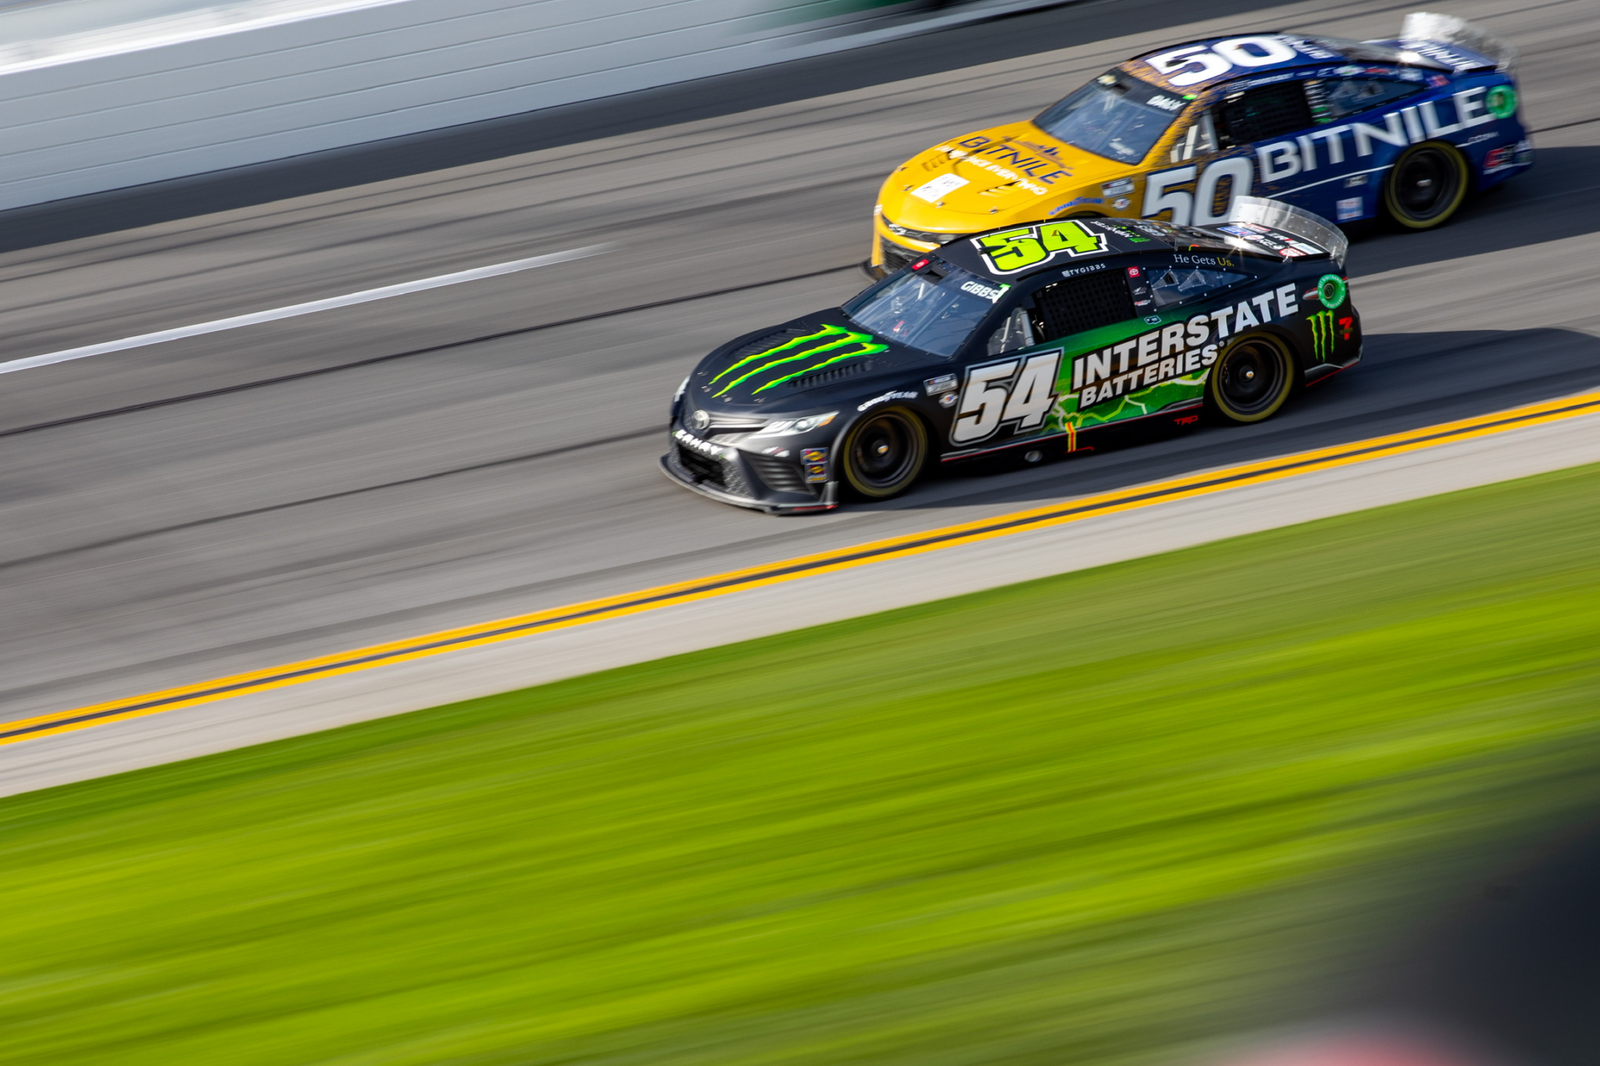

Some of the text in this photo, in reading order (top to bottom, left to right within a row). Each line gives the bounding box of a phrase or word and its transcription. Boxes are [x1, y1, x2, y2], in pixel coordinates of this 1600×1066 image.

[1145, 36, 1297, 86] 50
[1255, 86, 1496, 184] BITNILE
[1142, 157, 1253, 227] 50
[974, 220, 1105, 272] 54
[1173, 254, 1235, 267] He Gets Us.
[960, 281, 1000, 300] GIBBS
[1072, 283, 1298, 390] INTERSTATE
[951, 350, 1062, 443] 54
[1174, 415, 1198, 426] TRD
